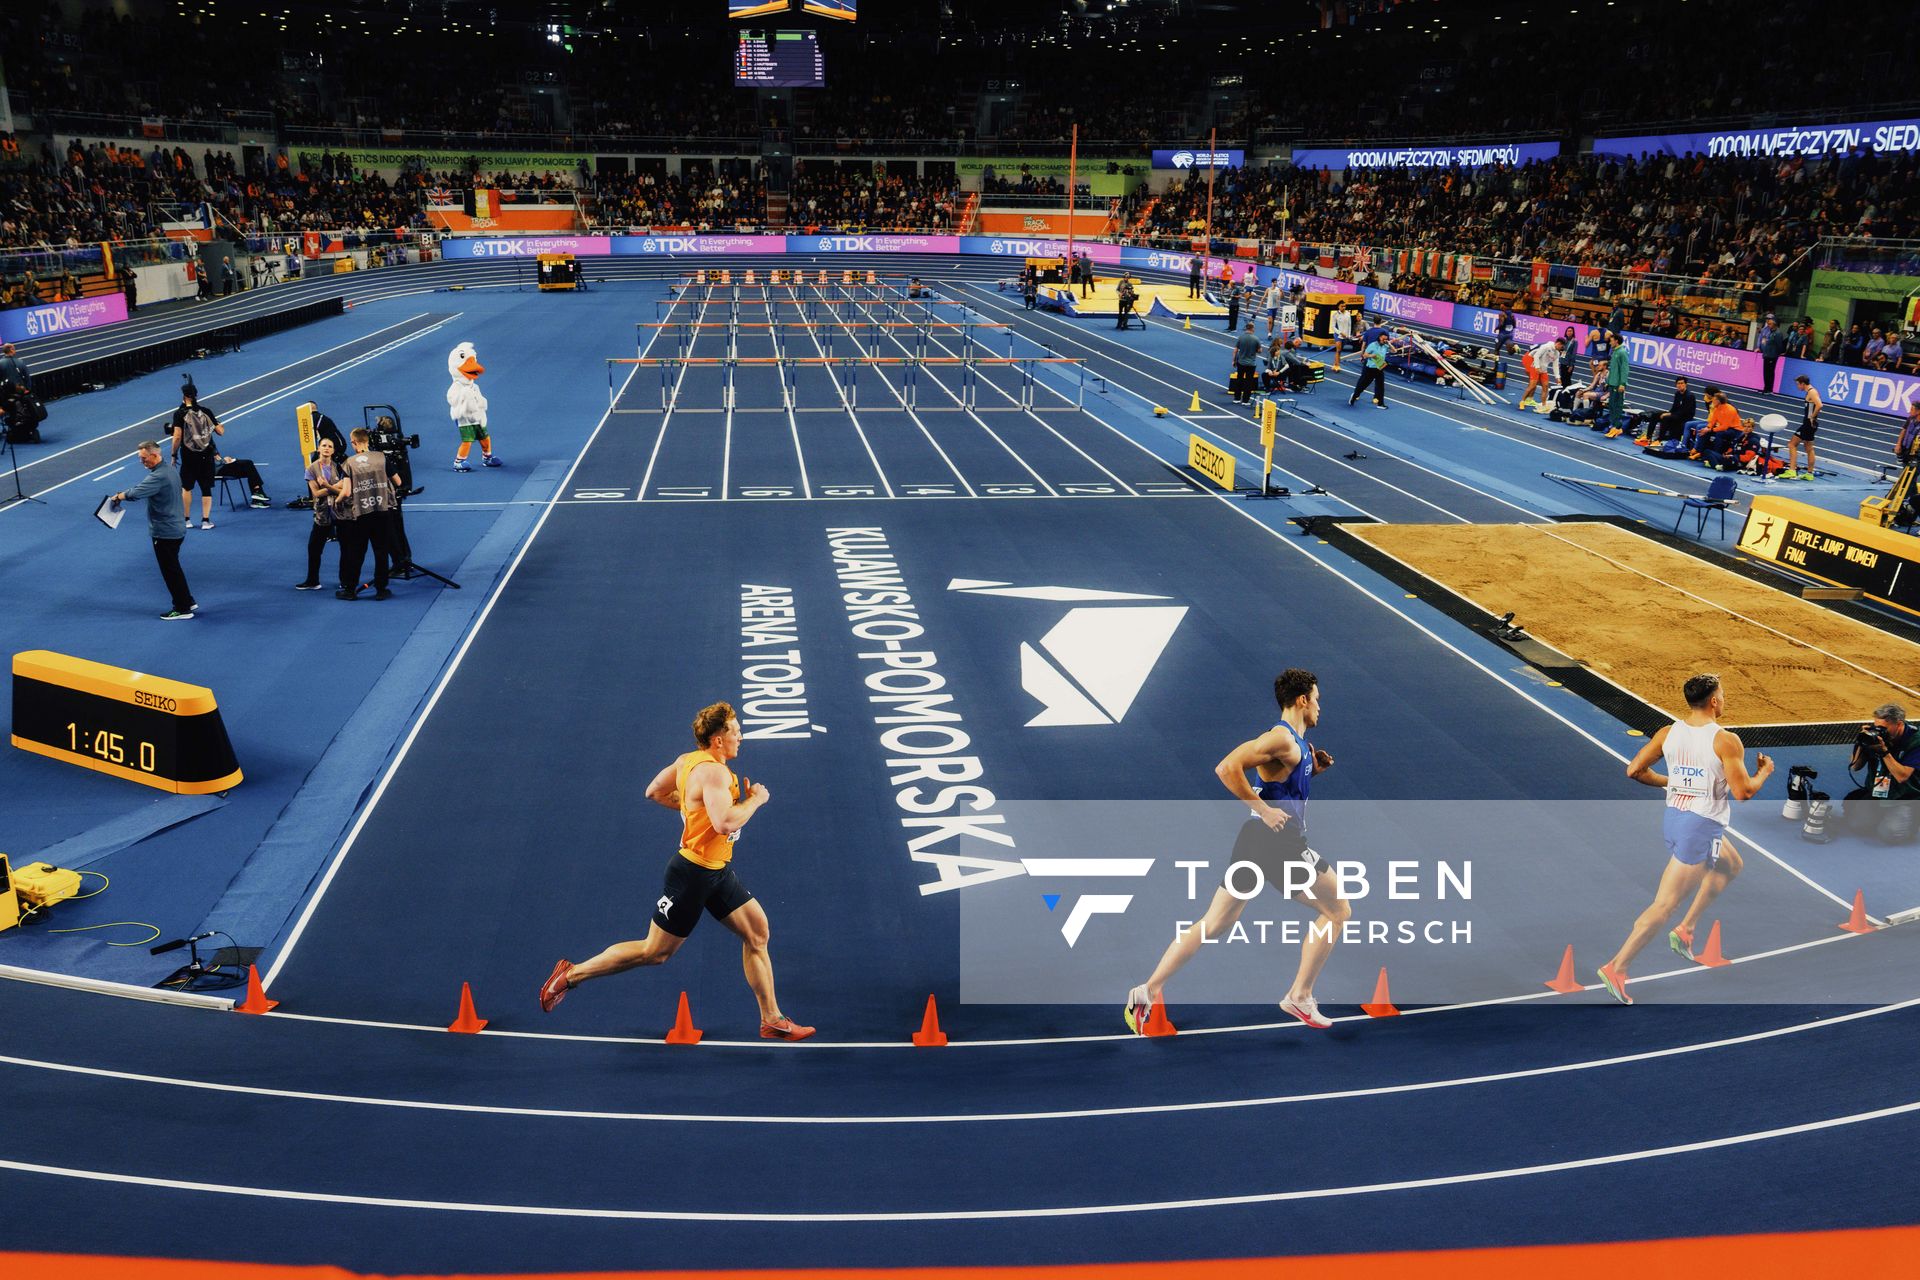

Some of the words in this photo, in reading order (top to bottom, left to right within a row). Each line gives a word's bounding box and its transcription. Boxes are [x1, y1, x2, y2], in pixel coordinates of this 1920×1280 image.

[1873, 124, 1920, 152] SIED
[495, 157, 531, 166] KUJAWY
[1347, 151, 1386, 167] 1000M
[484, 239, 526, 256] TDK
[526, 239, 534, 247] In
[535, 239, 579, 249] Everything,
[655, 238, 699, 252] TDK
[699, 245, 726, 253] Better
[708, 238, 754, 247] Everything,
[832, 237, 874, 251] TDK
[875, 244, 902, 252] Better
[884, 238, 928, 246] Everything,
[1003, 240, 1042, 256] TDK
[1044, 242, 1052, 250] In
[526, 247, 551, 255] Better
[1160, 254, 1192, 273] TDK
[69, 306, 75, 316] In
[1380, 293, 1401, 315] TDK
[35, 306, 71, 333] TDK
[70, 315, 90, 327] Better
[1515, 318, 1522, 328] In
[1522, 319, 1559, 337] Everything,
[1514, 328, 1535, 341] Better
[1629, 336, 1676, 369] TDK
[1677, 344, 1685, 358] In
[1686, 346, 1740, 370] Everything,
[1674, 358, 1705, 375] Better
[1850, 372, 1920, 414] TDK
[1195, 442, 1226, 481] SEIKO
[357, 478, 374, 486] HOST
[907, 487, 956, 495] 4
[986, 487, 1036, 495] 3
[360, 495, 383, 510] 389
[1784, 546, 1807, 566] FINAL
[1792, 528, 1821, 550] TRIPLE
[1819, 538, 1845, 557] JUMP
[1845, 545, 1879, 569] WOMEN
[741, 584, 798, 648] ARENA
[135, 690, 177, 712] SEIKO
[741, 649, 827, 740] TORUŃ
[825, 527, 1028, 896] KUJAWSKO-POMORSKA
[67, 722, 155, 772] 1:45.0
[1680, 766, 1704, 778] TDK
[1683, 777, 1692, 787] 11
